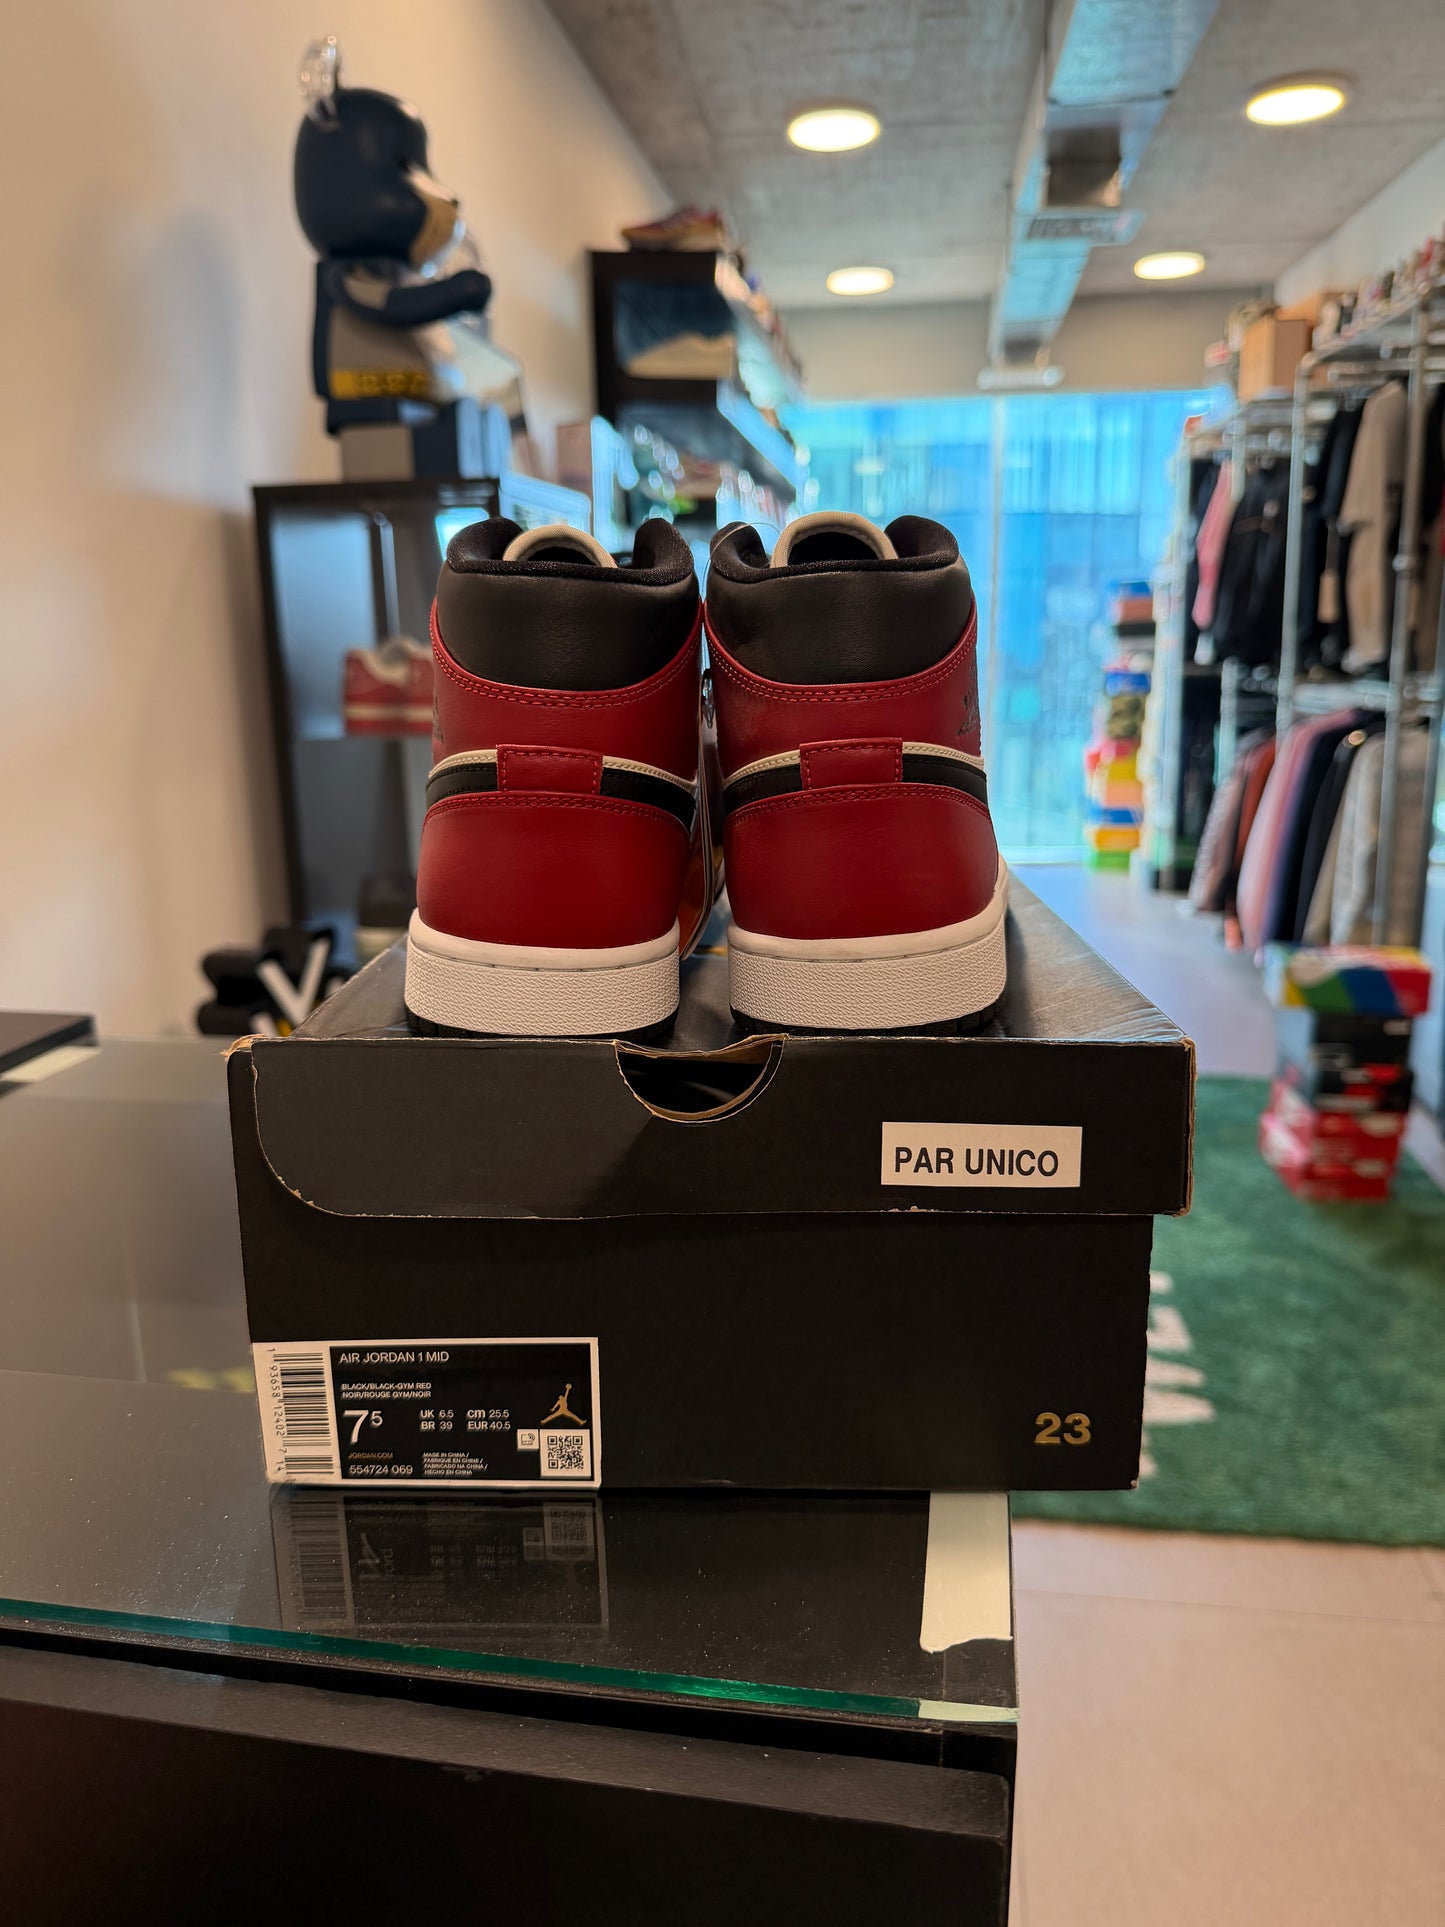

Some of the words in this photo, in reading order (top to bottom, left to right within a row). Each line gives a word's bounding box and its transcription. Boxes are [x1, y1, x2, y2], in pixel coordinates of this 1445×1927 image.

[895, 1147, 954, 1174] PAR
[965, 1148, 1059, 1177] UNICO
[339, 1352, 360, 1363] AIR
[363, 1351, 415, 1363] JORDAN
[418, 1352, 424, 1361] 1
[426, 1351, 450, 1362] MID
[269, 1365, 281, 1399] 93658
[341, 1382, 415, 1390] BLACK/BLACK-GYM
[416, 1382, 432, 1390] RED
[342, 1391, 391, 1399] NOIR/ROUGE
[392, 1390, 432, 1398] GYM/NOIR
[420, 1409, 435, 1419] UK
[439, 1409, 454, 1418] 6.5
[466, 1409, 486, 1418] cm
[488, 1409, 510, 1418] 25.5
[274, 1405, 285, 1436] 12402
[421, 1421, 436, 1430] BR
[440, 1421, 453, 1430] 39
[468, 1421, 488, 1430] EUR
[489, 1421, 511, 1430] 40.5
[1034, 1412, 1091, 1445] 23
[349, 1464, 389, 1474] 554724
[391, 1464, 413, 1474] 069
